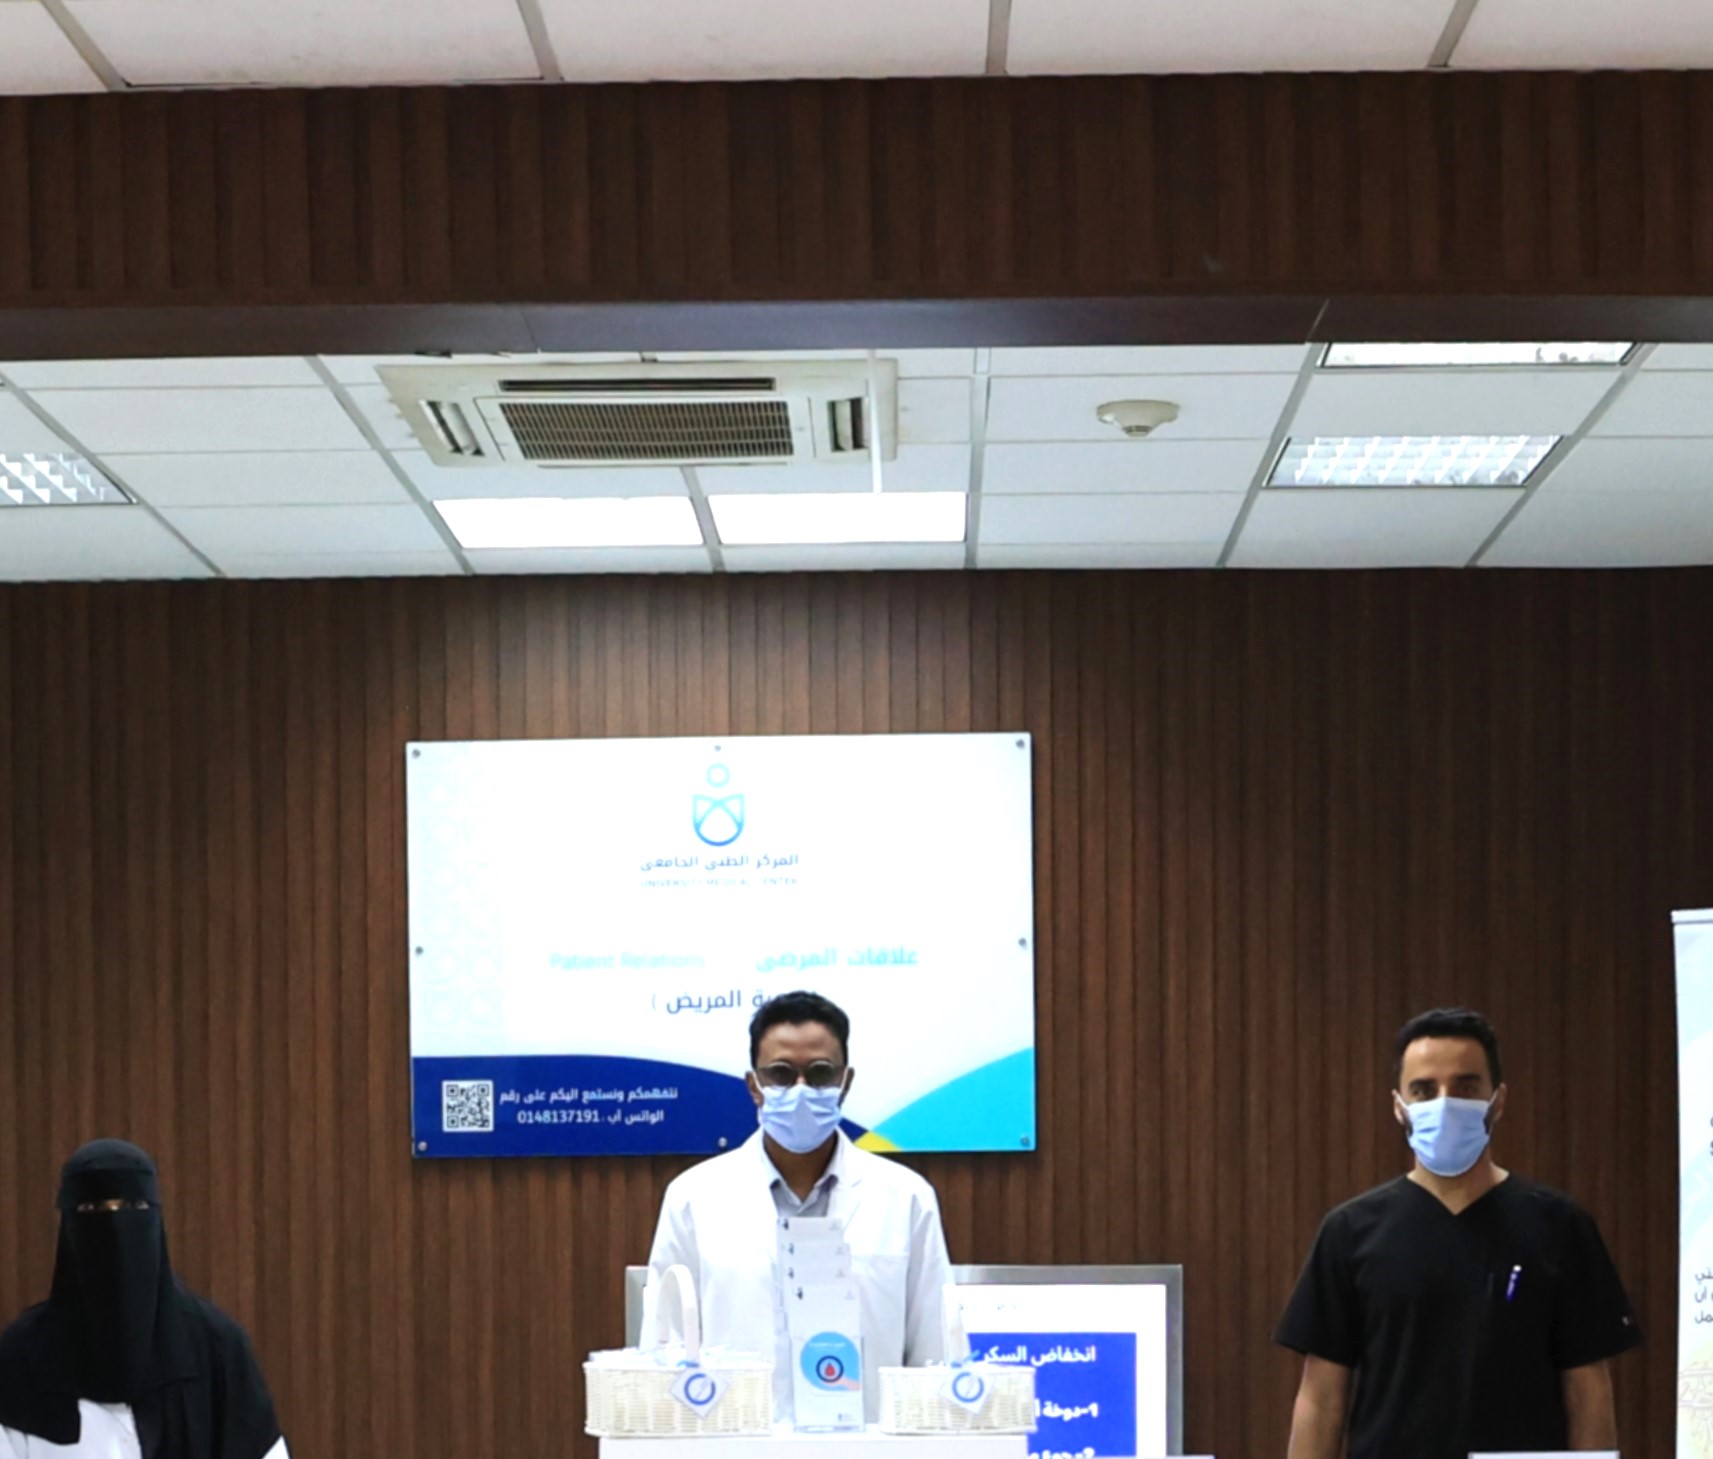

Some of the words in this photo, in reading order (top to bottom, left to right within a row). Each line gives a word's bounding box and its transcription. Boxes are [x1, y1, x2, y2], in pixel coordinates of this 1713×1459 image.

[666, 989, 742, 1015] المريض
[498, 1089, 521, 1105] رقم
[516, 1109, 601, 1125] 0148137191
[624, 1109, 665, 1126] الواتس
[1031, 1346, 1096, 1366] انخفاض
